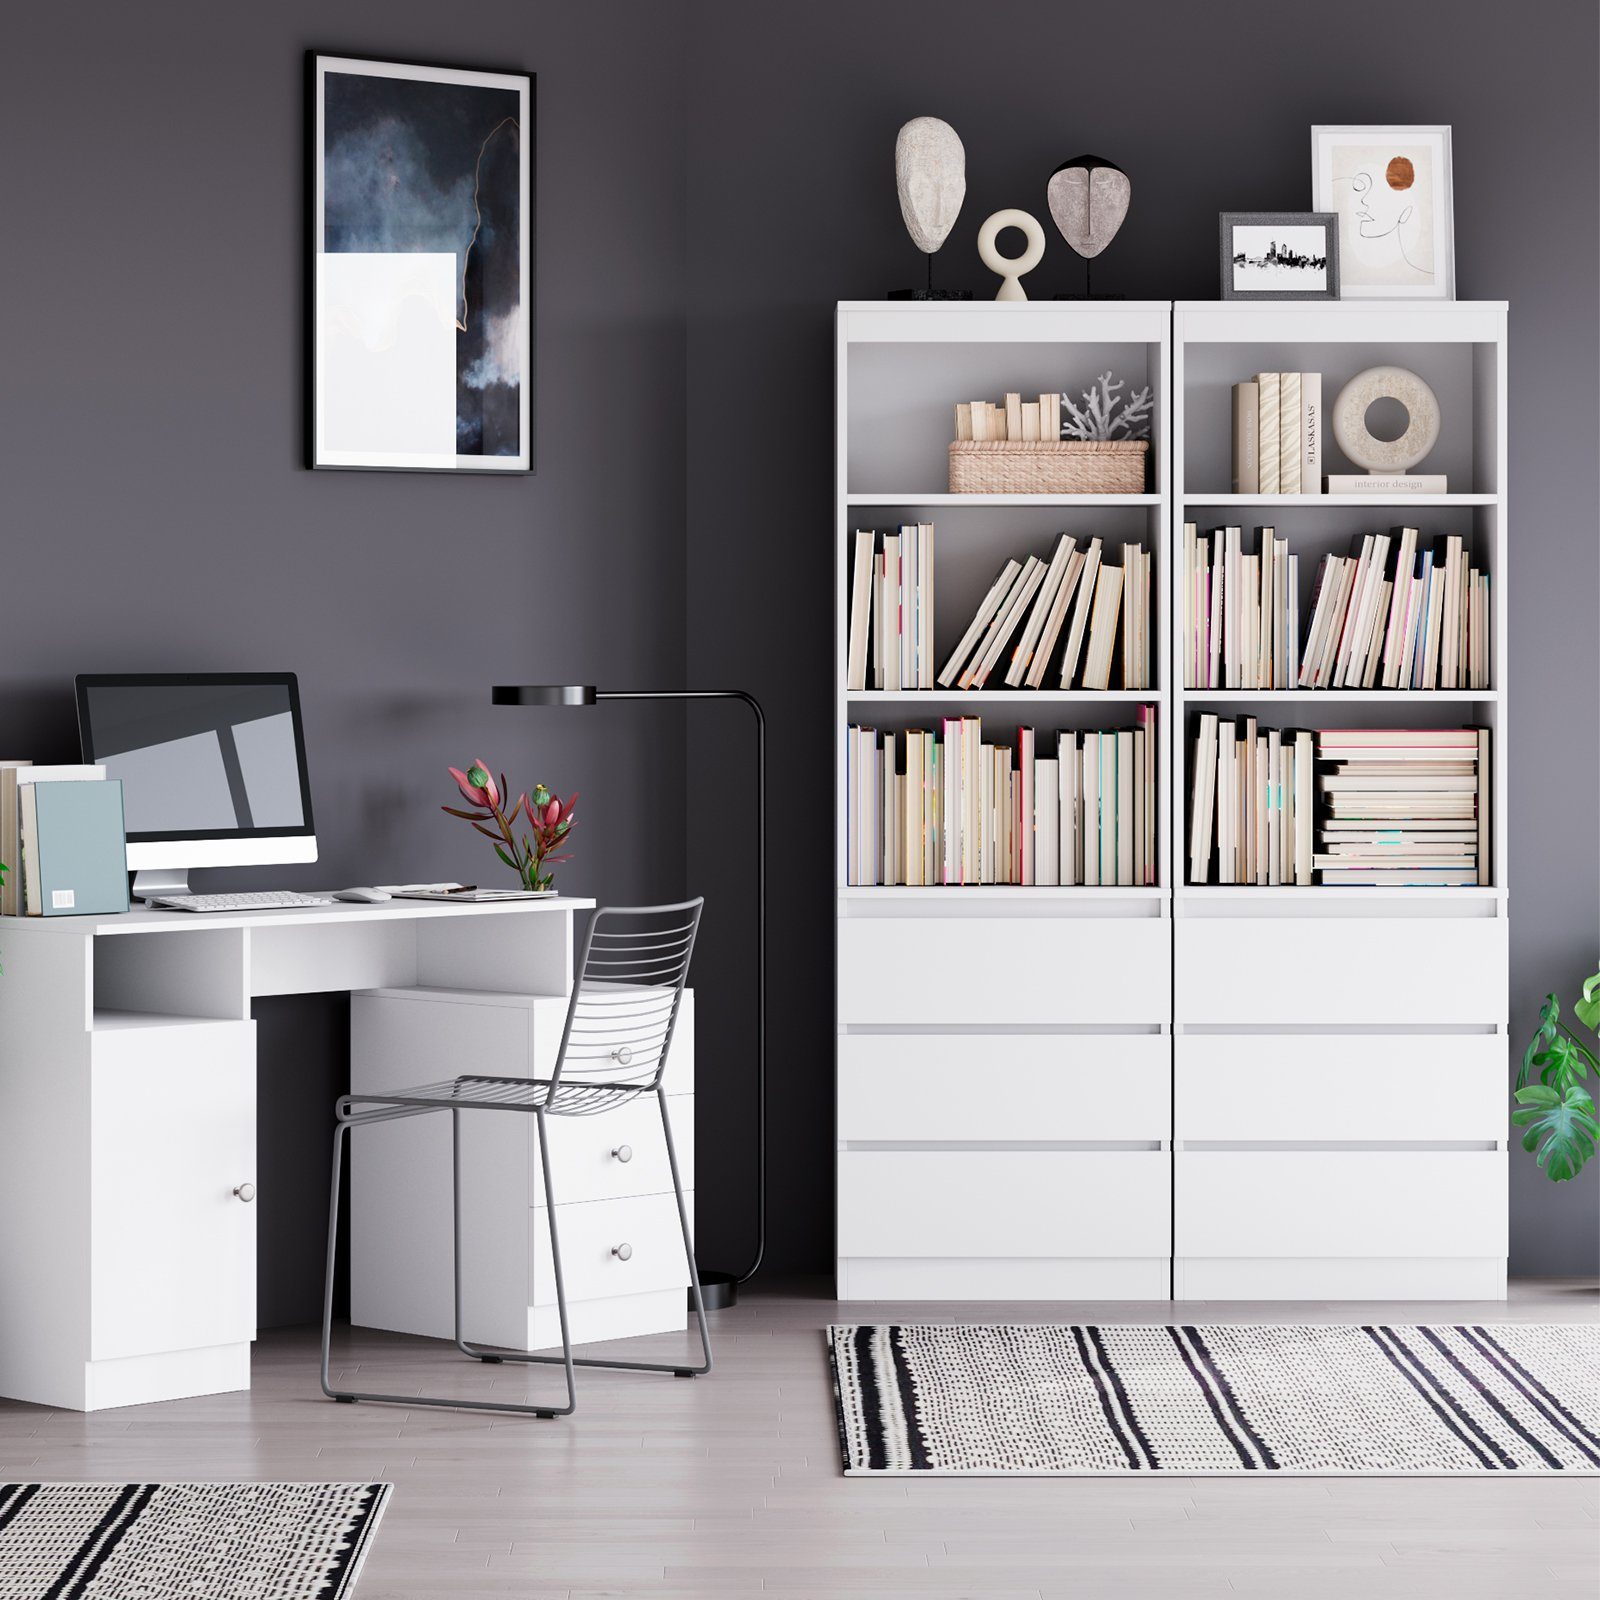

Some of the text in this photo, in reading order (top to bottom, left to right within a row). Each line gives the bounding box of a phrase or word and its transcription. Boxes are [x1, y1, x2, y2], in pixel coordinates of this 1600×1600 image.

[1307, 404, 1315, 455] LASKASAS
[1354, 480, 1423, 489] interior design
